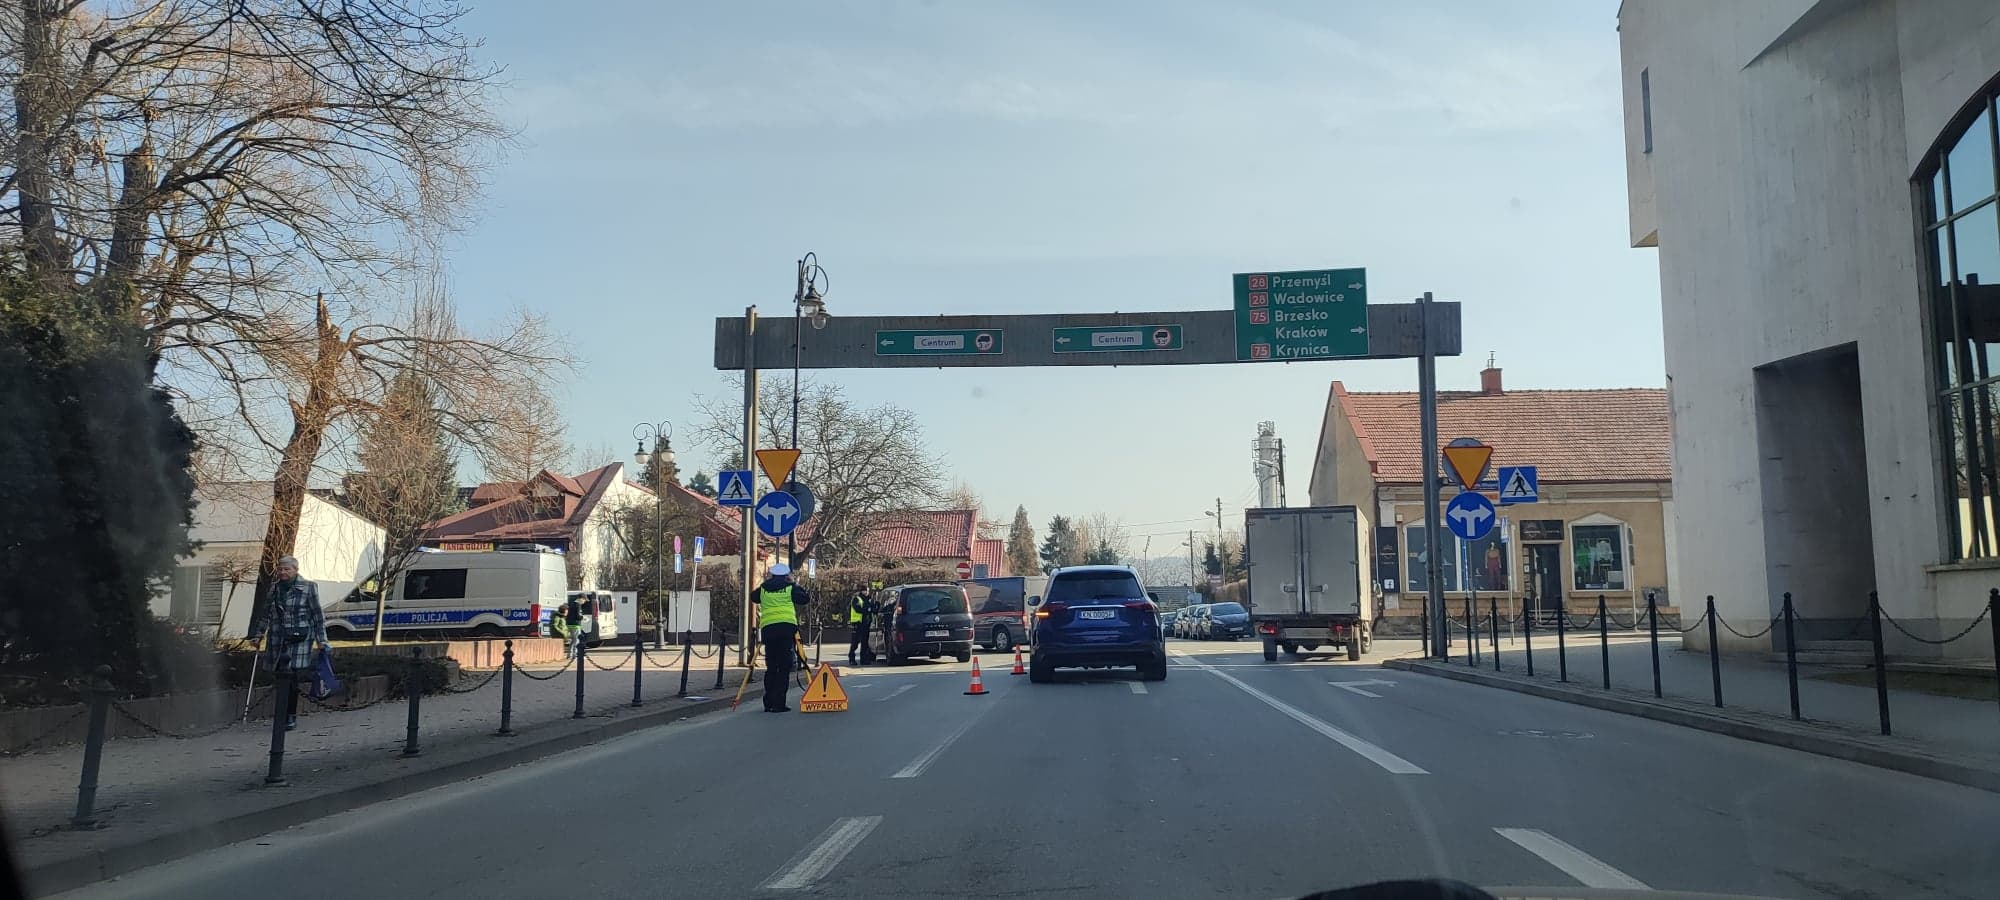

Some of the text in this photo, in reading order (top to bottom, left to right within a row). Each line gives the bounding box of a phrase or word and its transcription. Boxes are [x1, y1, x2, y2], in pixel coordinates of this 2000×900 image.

[1252, 274, 1331, 289] 28 Przemyśl
[1252, 291, 1345, 305] 28 Wadowice
[1253, 309, 1328, 322] 75 Brzesko
[1275, 325, 1328, 339] Kraków
[920, 338, 957, 347] Centrum
[1098, 335, 1135, 344] Centrum
[1254, 343, 1329, 357] 75 Krynica
[411, 613, 448, 622] POLICJA
